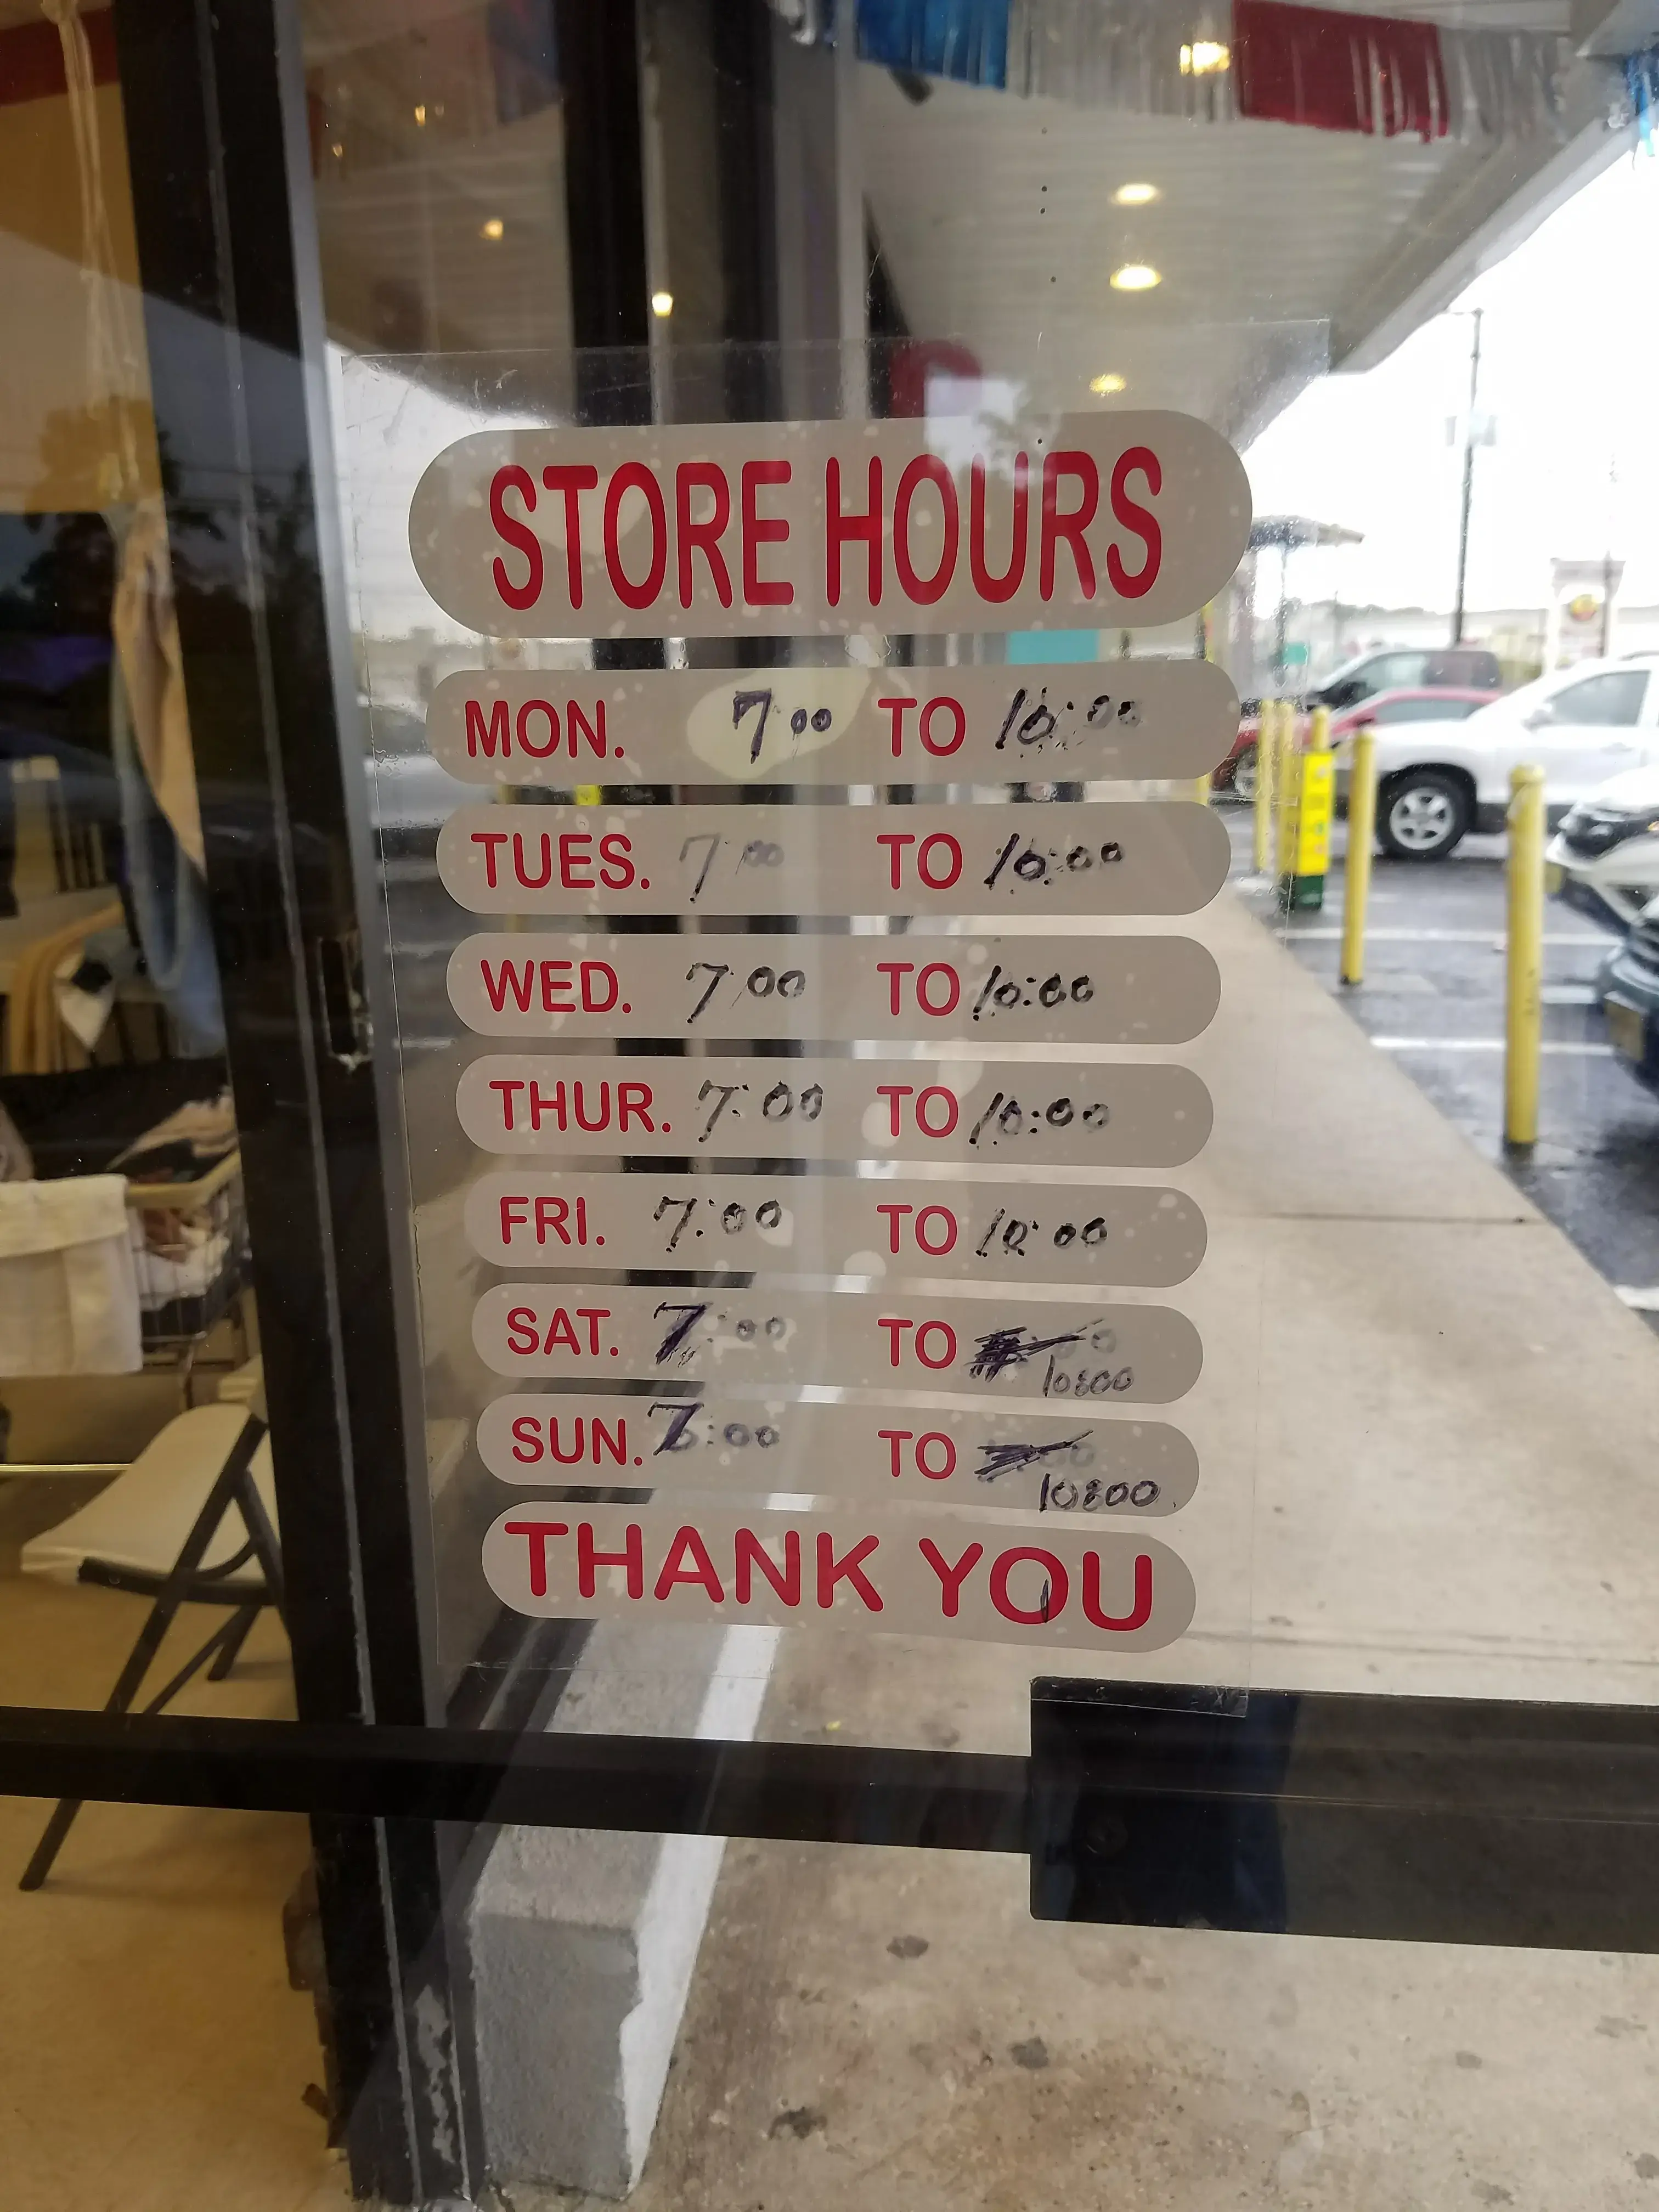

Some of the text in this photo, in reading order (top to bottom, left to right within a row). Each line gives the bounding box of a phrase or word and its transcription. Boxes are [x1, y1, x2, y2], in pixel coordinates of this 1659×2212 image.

[489, 445, 1163, 611] STORE HOURS
[465, 699, 625, 759] MON.
[877, 696, 967, 758] TO
[470, 832, 651, 890] TUES.
[876, 832, 963, 890] TO
[479, 959, 632, 1014] WED.
[876, 962, 961, 1017] TO
[488, 1080, 672, 1133] THUR.
[876, 1085, 959, 1138] TO
[499, 1195, 606, 1246] FRI.
[876, 1204, 958, 1256] TO
[506, 1306, 619, 1357] SAT.
[877, 1318, 957, 1370] TO
[511, 1416, 643, 1466] SUN.
[877, 1430, 957, 1480] TO
[504, 1521, 1153, 1632] THANK YOU
